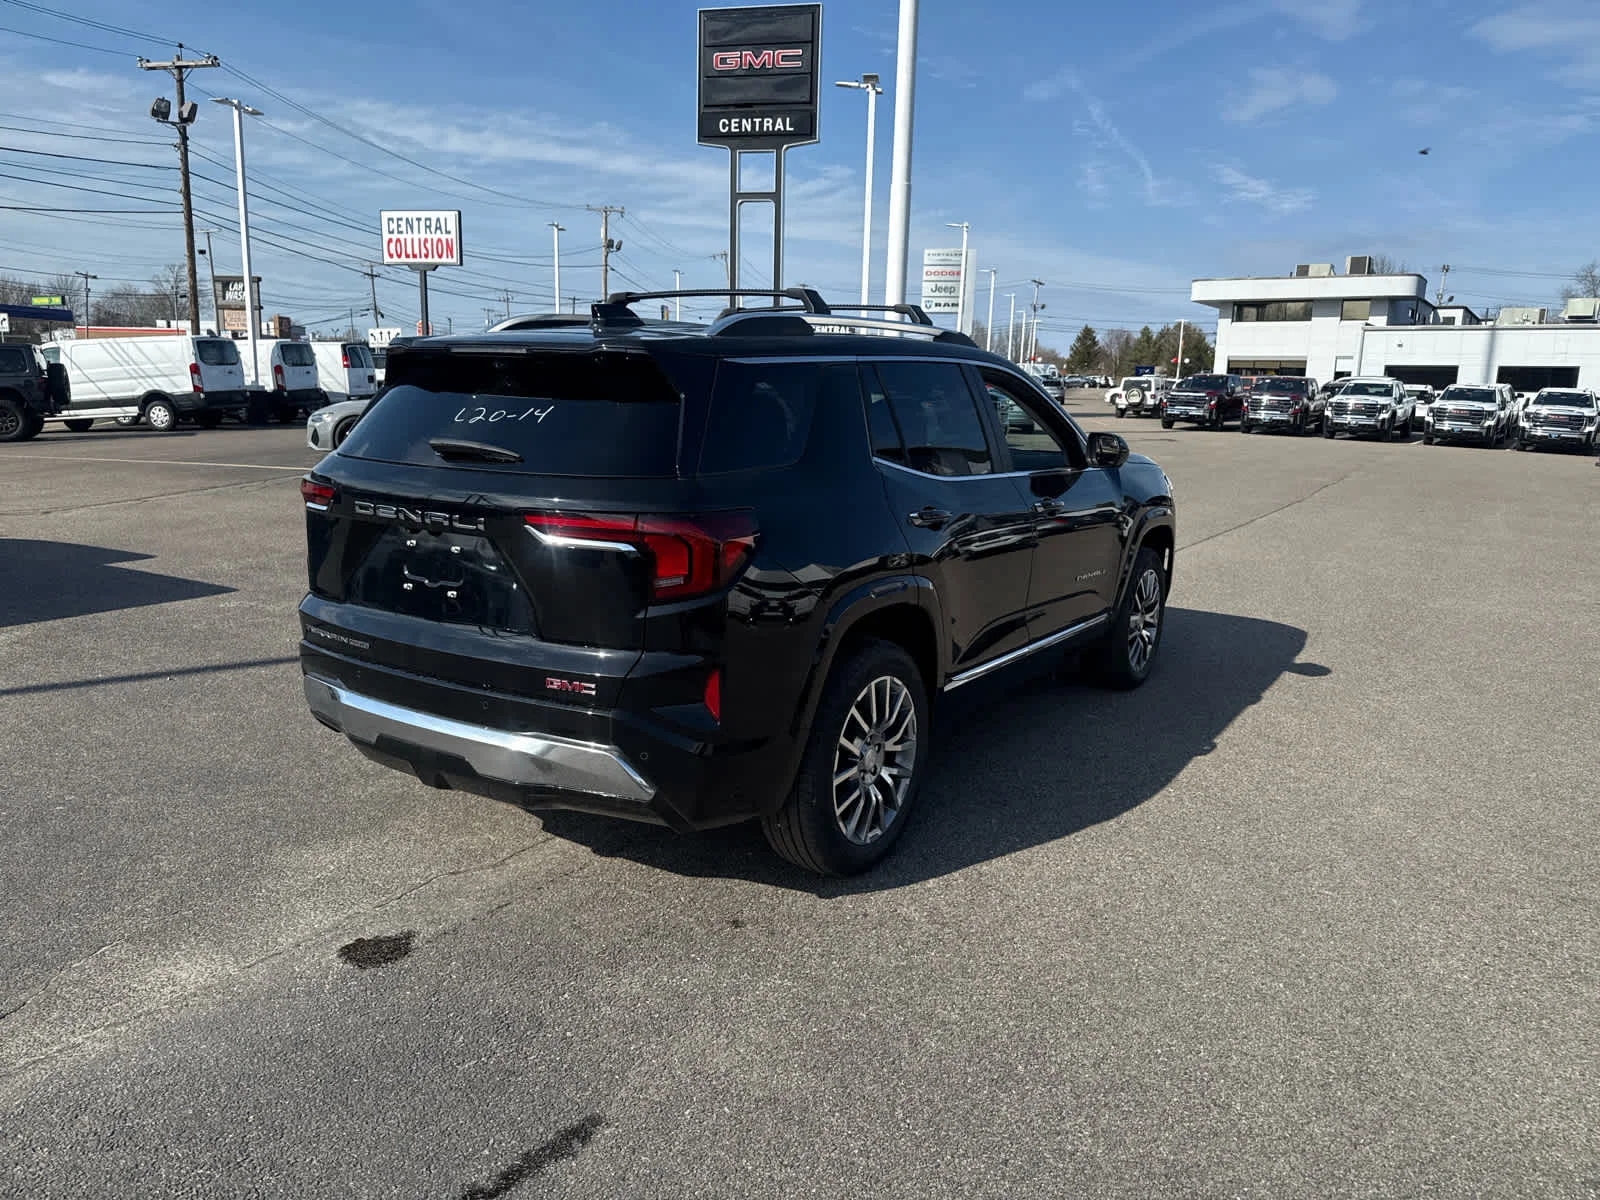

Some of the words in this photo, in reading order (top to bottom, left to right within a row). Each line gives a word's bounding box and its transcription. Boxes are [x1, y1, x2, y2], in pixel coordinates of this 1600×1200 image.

[713, 49, 802, 70] GMC
[719, 117, 794, 133] CENTRAL
[387, 217, 451, 235] CENTRAL
[387, 237, 454, 259] COLLISION
[930, 283, 956, 295] Jeep
[354, 500, 485, 531] DENALI
[545, 677, 597, 696] GMC
